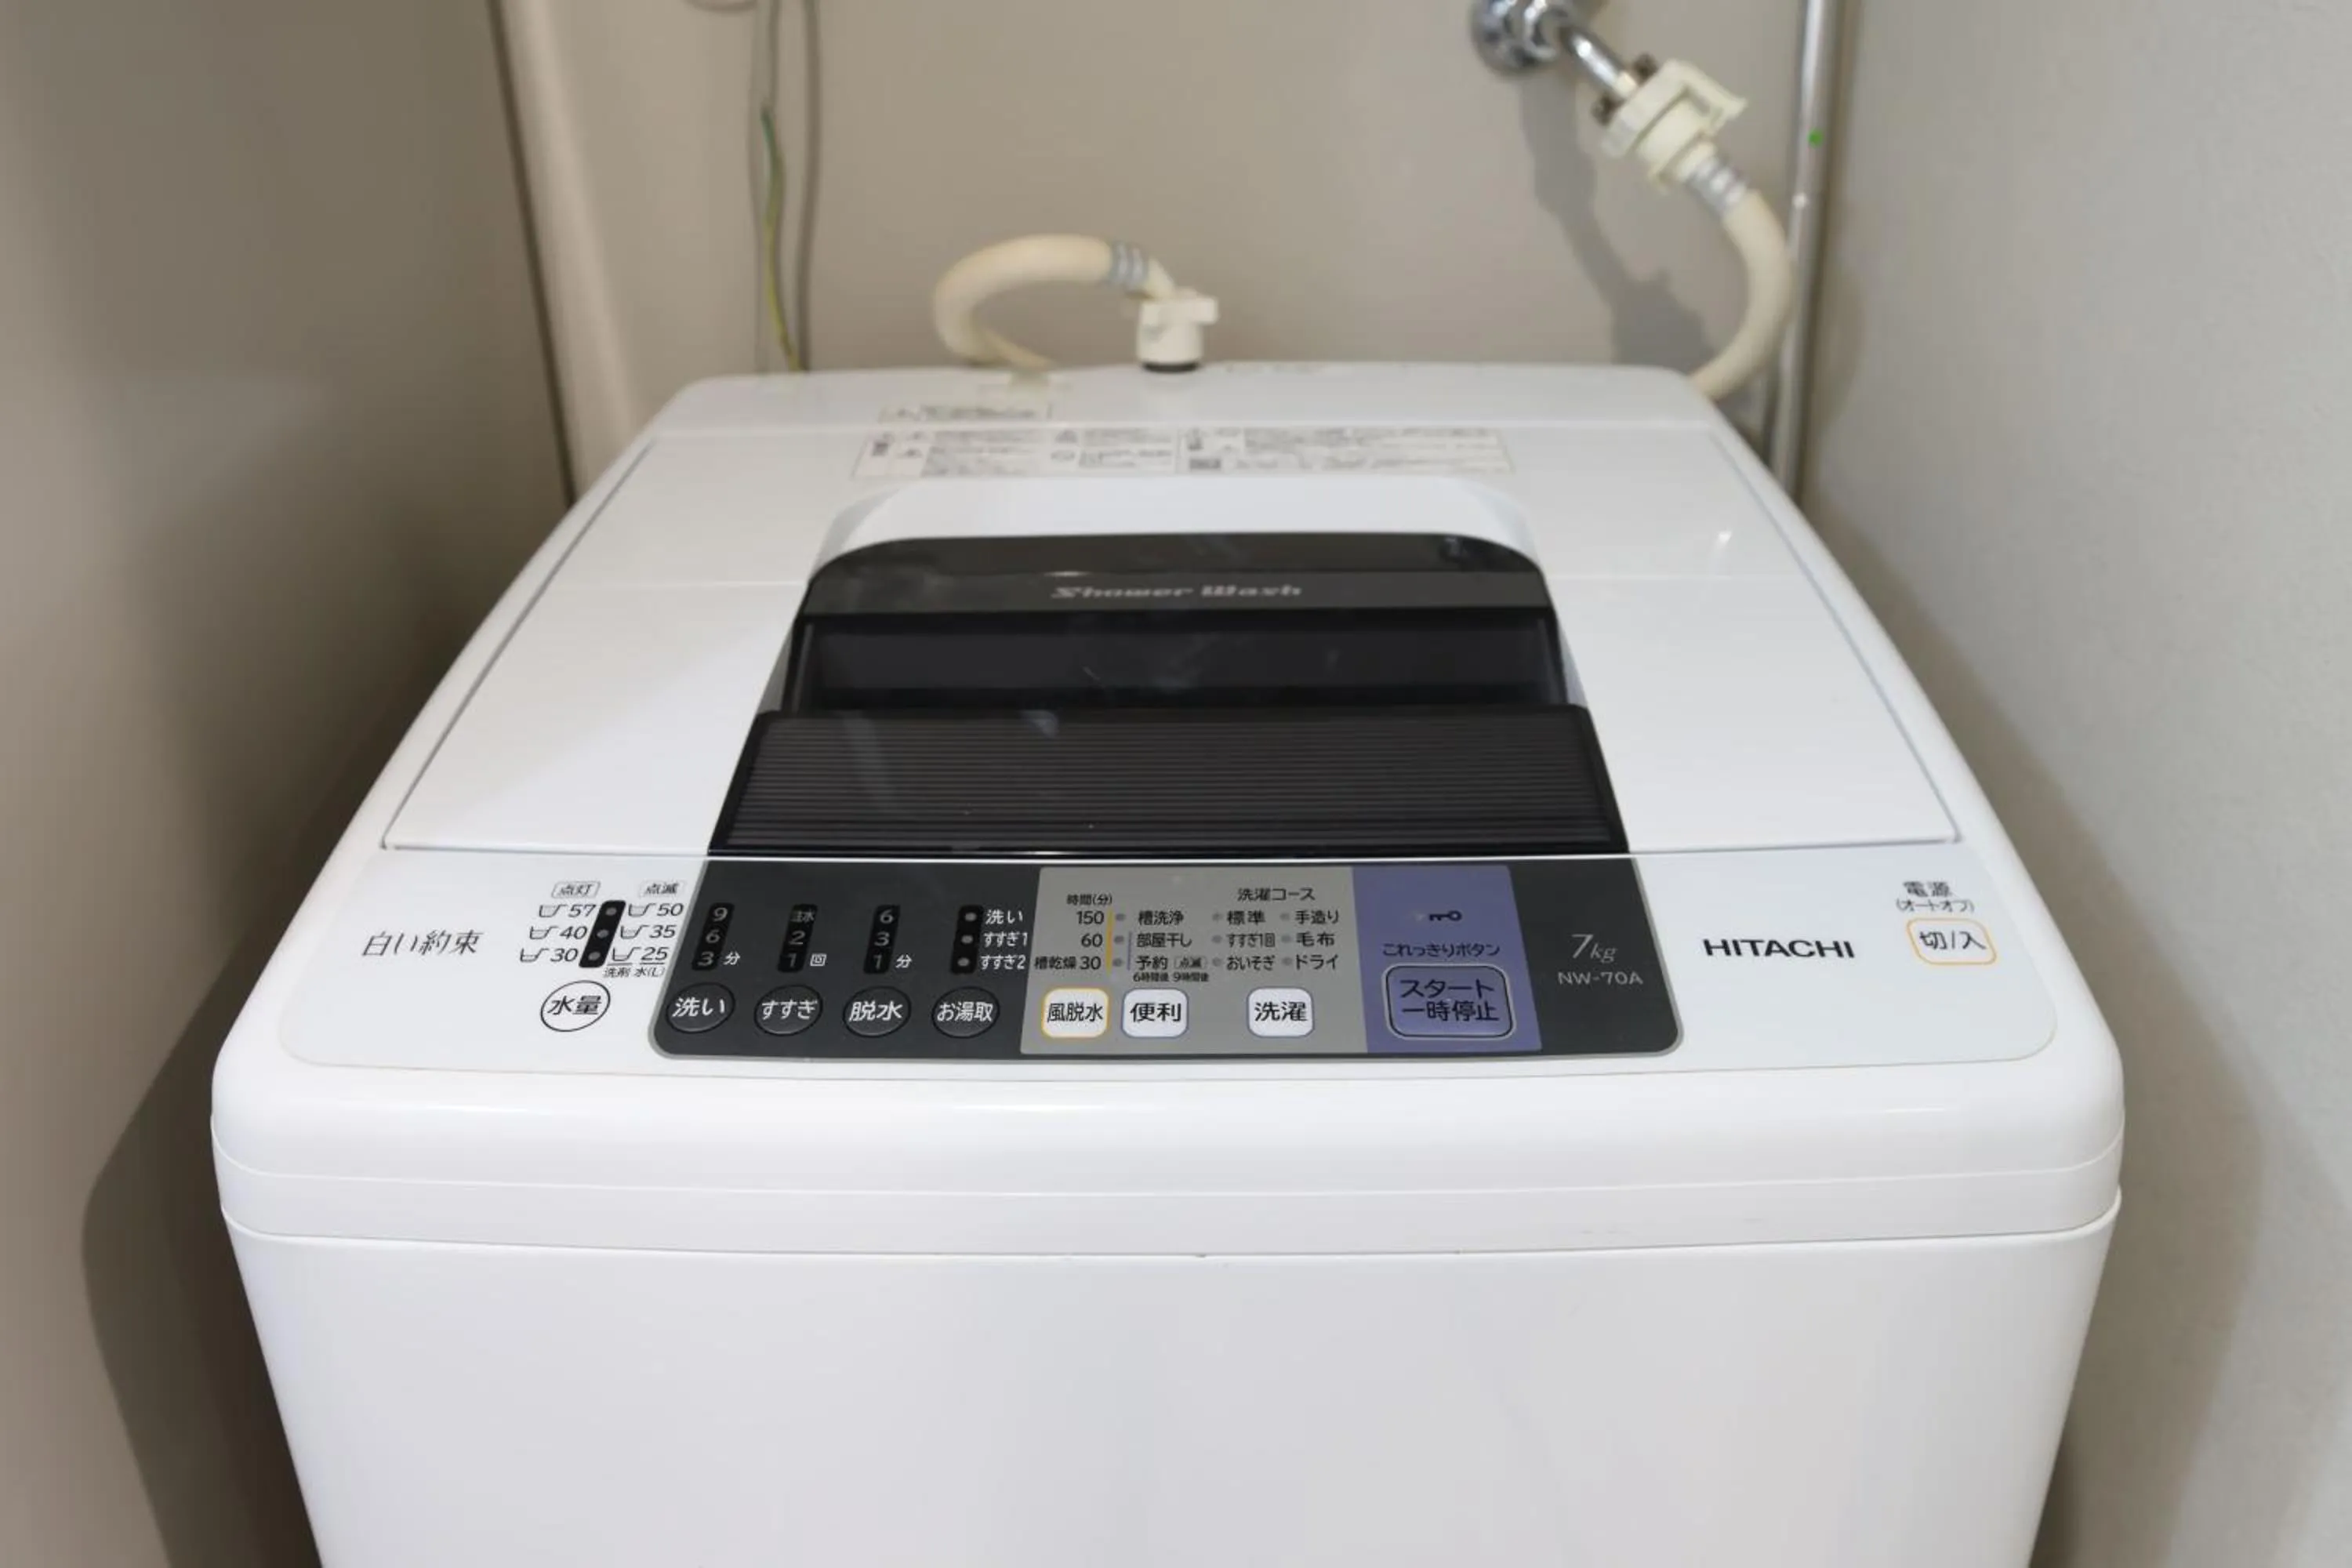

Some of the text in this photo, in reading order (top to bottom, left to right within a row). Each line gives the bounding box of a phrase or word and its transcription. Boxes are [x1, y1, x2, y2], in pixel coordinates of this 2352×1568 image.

[1237, 887, 1316, 902] 洗濯コース
[1903, 880, 1952, 898] 電源
[568, 903, 596, 918] 57
[656, 902, 684, 917] 50
[710, 906, 728, 923] 9
[880, 907, 894, 924] 6
[985, 909, 1023, 924] 洗い
[1076, 910, 1105, 925] 150
[1226, 909, 1266, 926] 標準
[1295, 909, 1339, 924] 手造り
[1138, 910, 1185, 926] 槽洗浄
[559, 924, 588, 940] 40
[649, 924, 677, 938] 35
[706, 929, 720, 944] 6
[788, 931, 805, 946] 2
[874, 931, 890, 946] 3
[1296, 931, 1335, 947] 毛布
[361, 930, 483, 956] 白い約束
[983, 932, 1028, 948] すすぎ1
[1080, 933, 1103, 948] 60
[1136, 933, 1192, 949] 部屋干し
[1226, 932, 1276, 948] すすぎ1回
[1703, 938, 1856, 958] HITACHI
[550, 948, 579, 962] 30
[641, 946, 669, 960] 25
[1382, 943, 1500, 956] これっきりボタン
[697, 951, 715, 967] 3
[724, 952, 741, 967] 分
[786, 953, 797, 967] 1
[810, 953, 827, 967] 回
[873, 953, 884, 968] 1
[896, 954, 913, 968] 分
[980, 953, 1025, 970] すすぎ2
[1080, 956, 1102, 970] 30
[1135, 956, 1168, 971] 予約
[1226, 954, 1276, 971] おいそぎ
[1295, 954, 1339, 971] ドライ
[1558, 971, 1643, 985] NW-70A
[1400, 979, 1494, 999] スタート
[547, 996, 602, 1016] 水量
[672, 998, 725, 1017] 洗い
[761, 1000, 818, 1020] すすぎ
[849, 1001, 903, 1021] 脱水
[936, 1001, 993, 1022] お湯取
[1047, 1004, 1104, 1022] 風脱水
[1130, 1003, 1182, 1022] 便利
[1254, 1002, 1308, 1022] 洗濯
[1402, 1000, 1500, 1022] 一時停止
